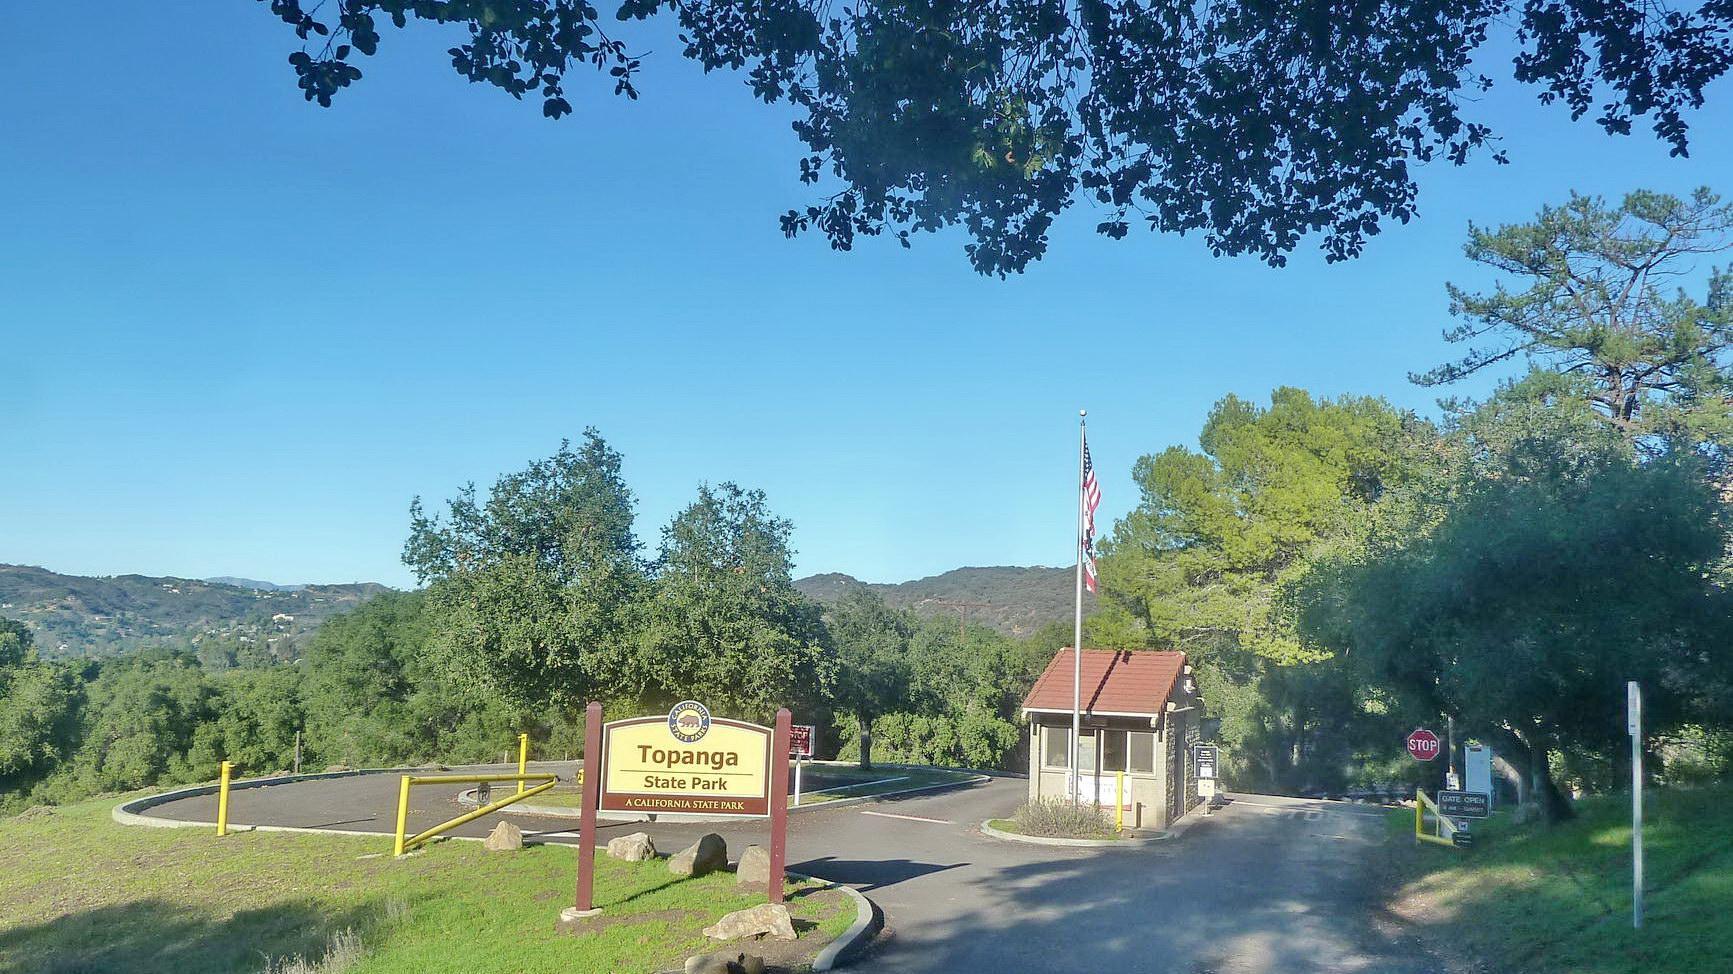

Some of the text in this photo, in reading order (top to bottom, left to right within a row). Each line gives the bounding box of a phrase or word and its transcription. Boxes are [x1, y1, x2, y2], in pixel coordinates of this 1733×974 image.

[671, 703, 708, 720] CALIFORNIA
[671, 724, 708, 741] STATE PARKS
[1409, 739, 1437, 751] STOP
[637, 745, 738, 770] Topanga
[644, 776, 728, 790] State Park
[634, 799, 691, 808] CALIFORNIA
[693, 801, 719, 809] STATE
[720, 802, 745, 810] PARK
